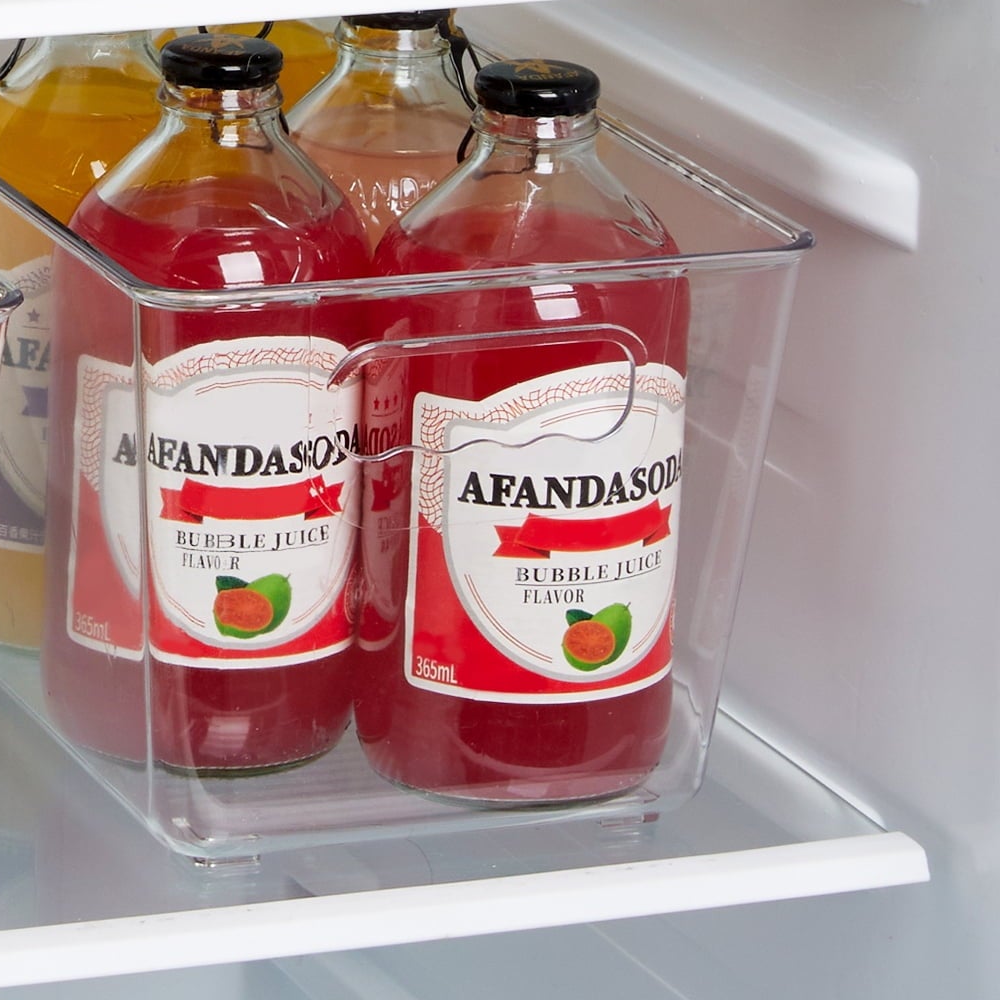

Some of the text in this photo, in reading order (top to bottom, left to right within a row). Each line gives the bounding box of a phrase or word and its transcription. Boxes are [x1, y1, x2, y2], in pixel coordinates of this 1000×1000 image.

[271, 525, 330, 550] JUICE
[515, 549, 662, 583] BUBBLE JUICE
[522, 588, 585, 605] FLAVOR
[415, 655, 459, 685] 365mL
